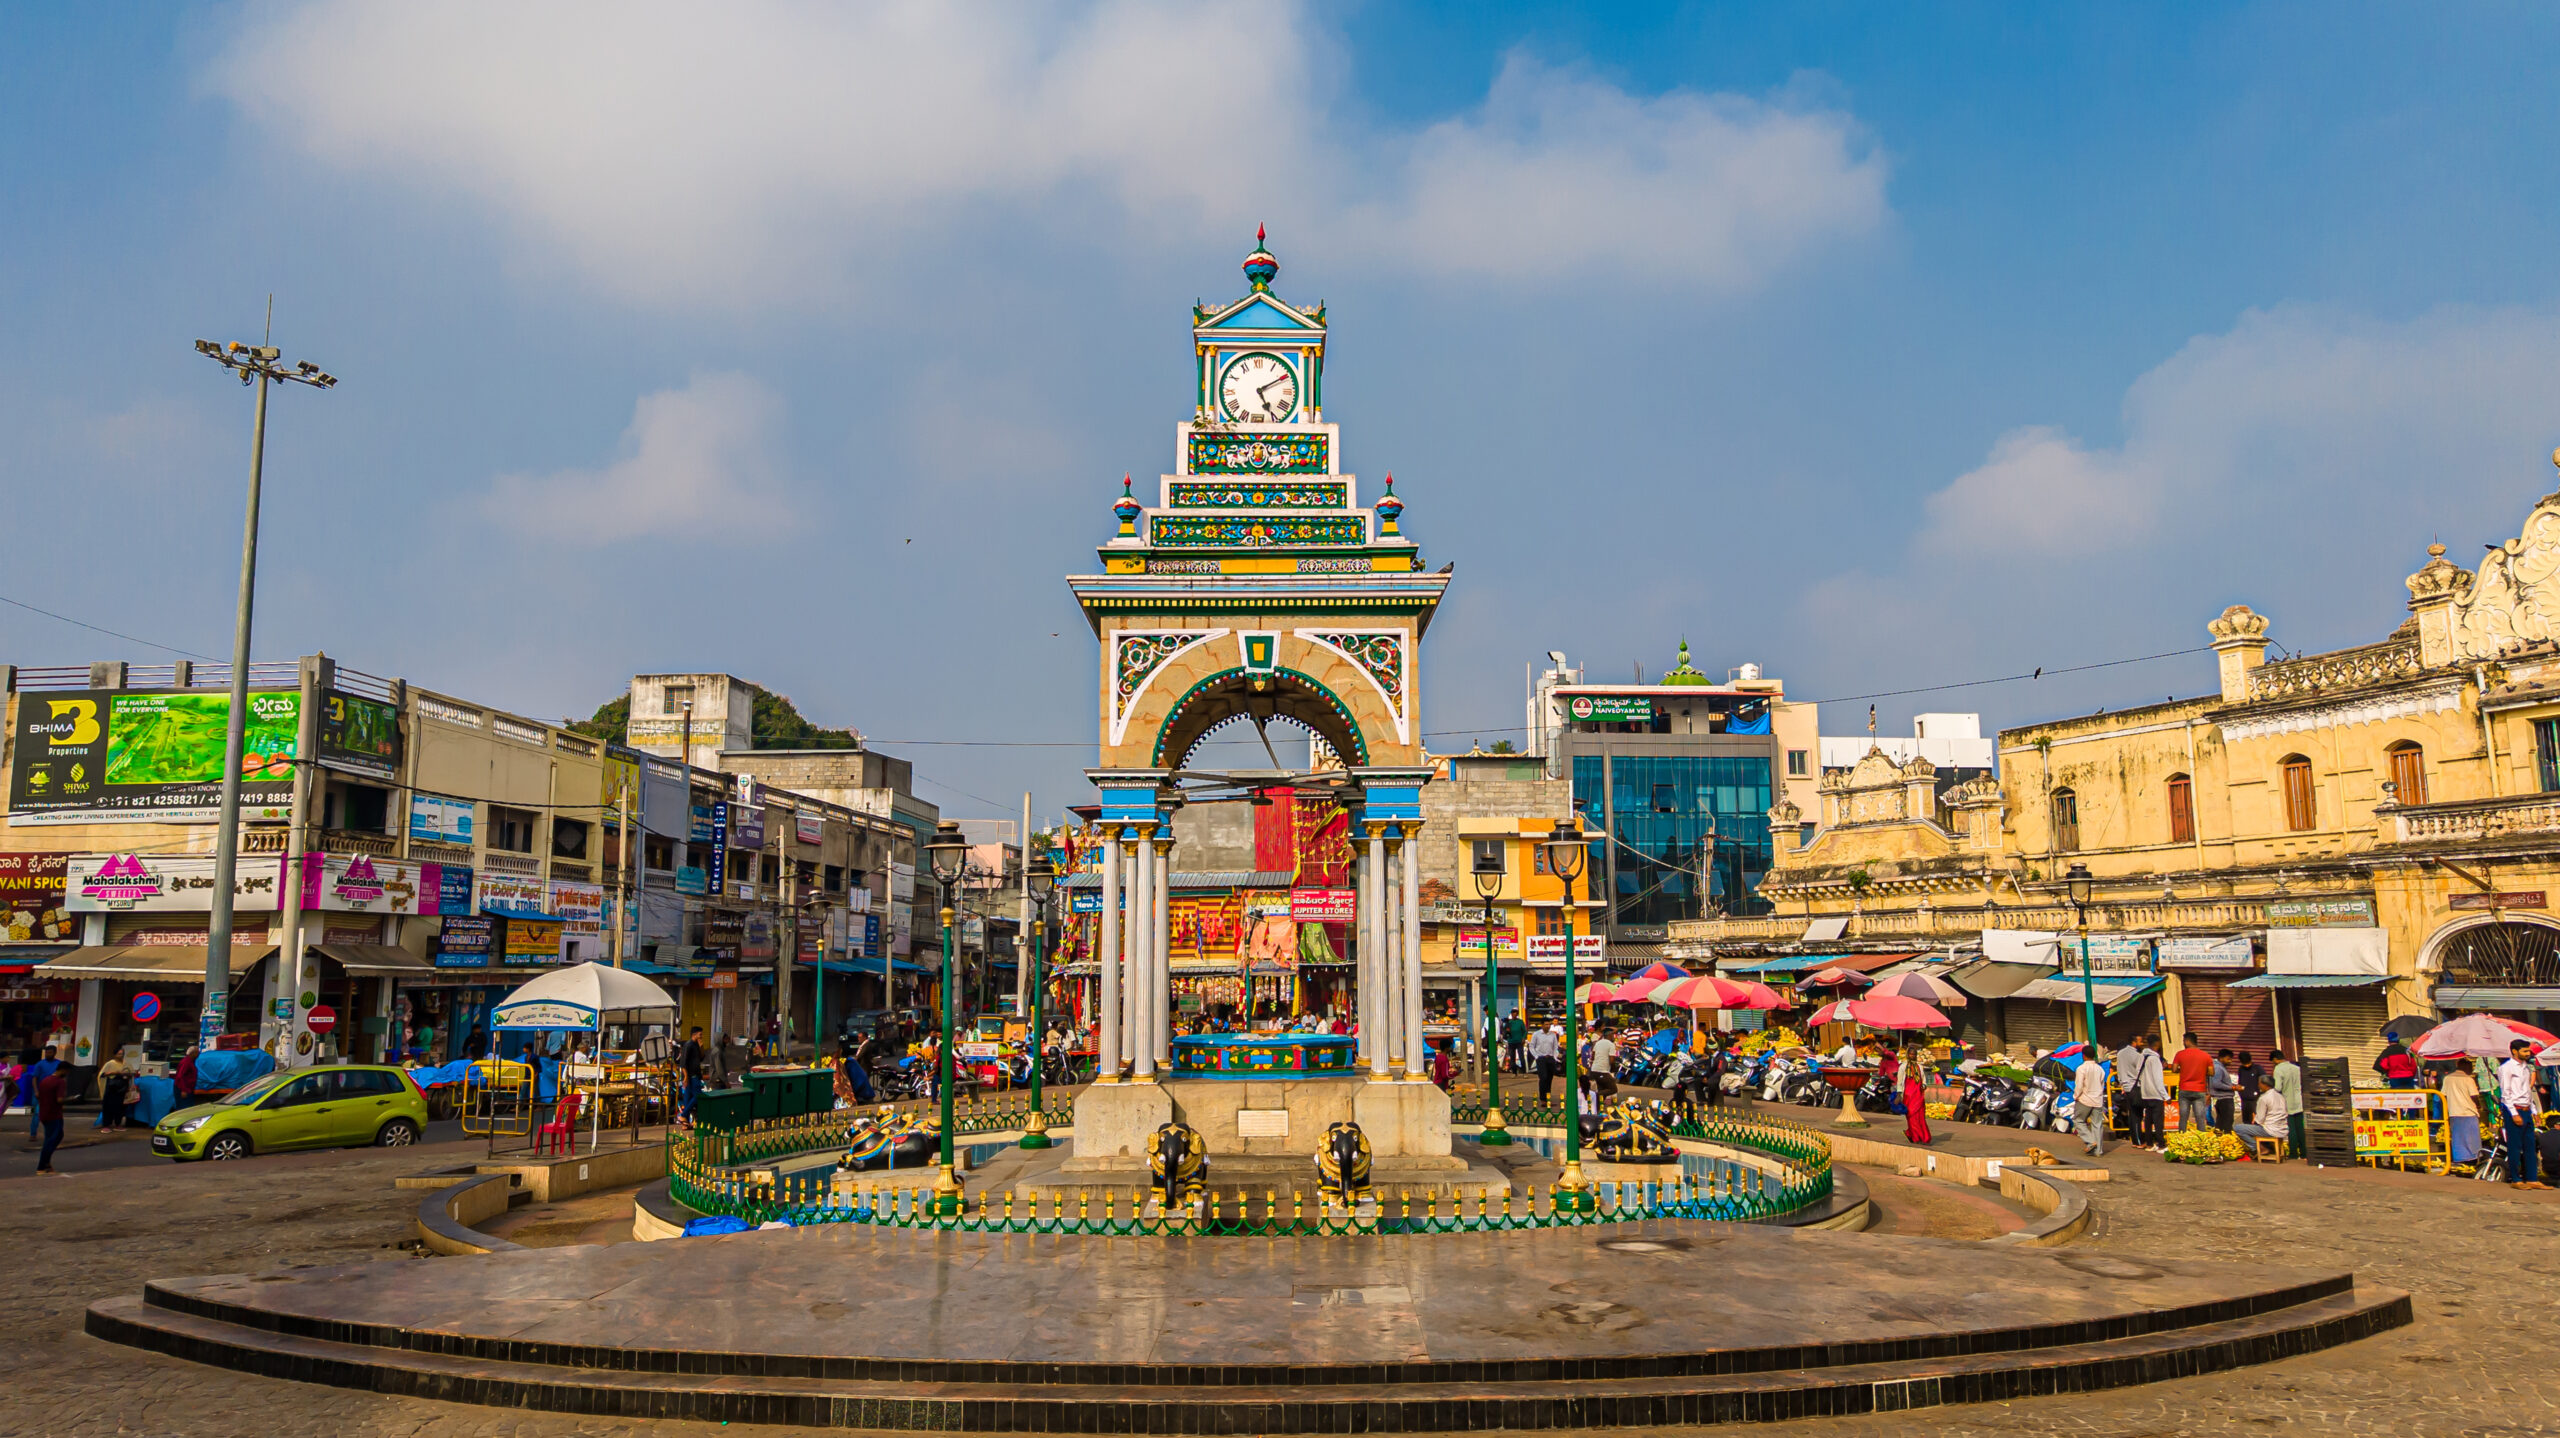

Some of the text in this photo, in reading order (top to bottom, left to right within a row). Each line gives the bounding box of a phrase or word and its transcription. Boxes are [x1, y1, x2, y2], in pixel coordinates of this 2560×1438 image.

[29, 723, 76, 734] BHIMA
[48, 747, 89, 756] Properties
[63, 782, 90, 791] SHIVAS
[132, 796, 151, 806] 821
[153, 794, 198, 806] 4258821
[85, 812, 104, 820] LIVING
[83, 875, 160, 886] Mahalakshmi
[336, 874, 385, 889] Mahalakshmi
[105, 889, 138, 898] SWEETS
[107, 899, 132, 907] MYSURU
[490, 897, 511, 910] SUNIL
[515, 899, 541, 912] STORES
[2271, 914, 2317, 927] PRIME
